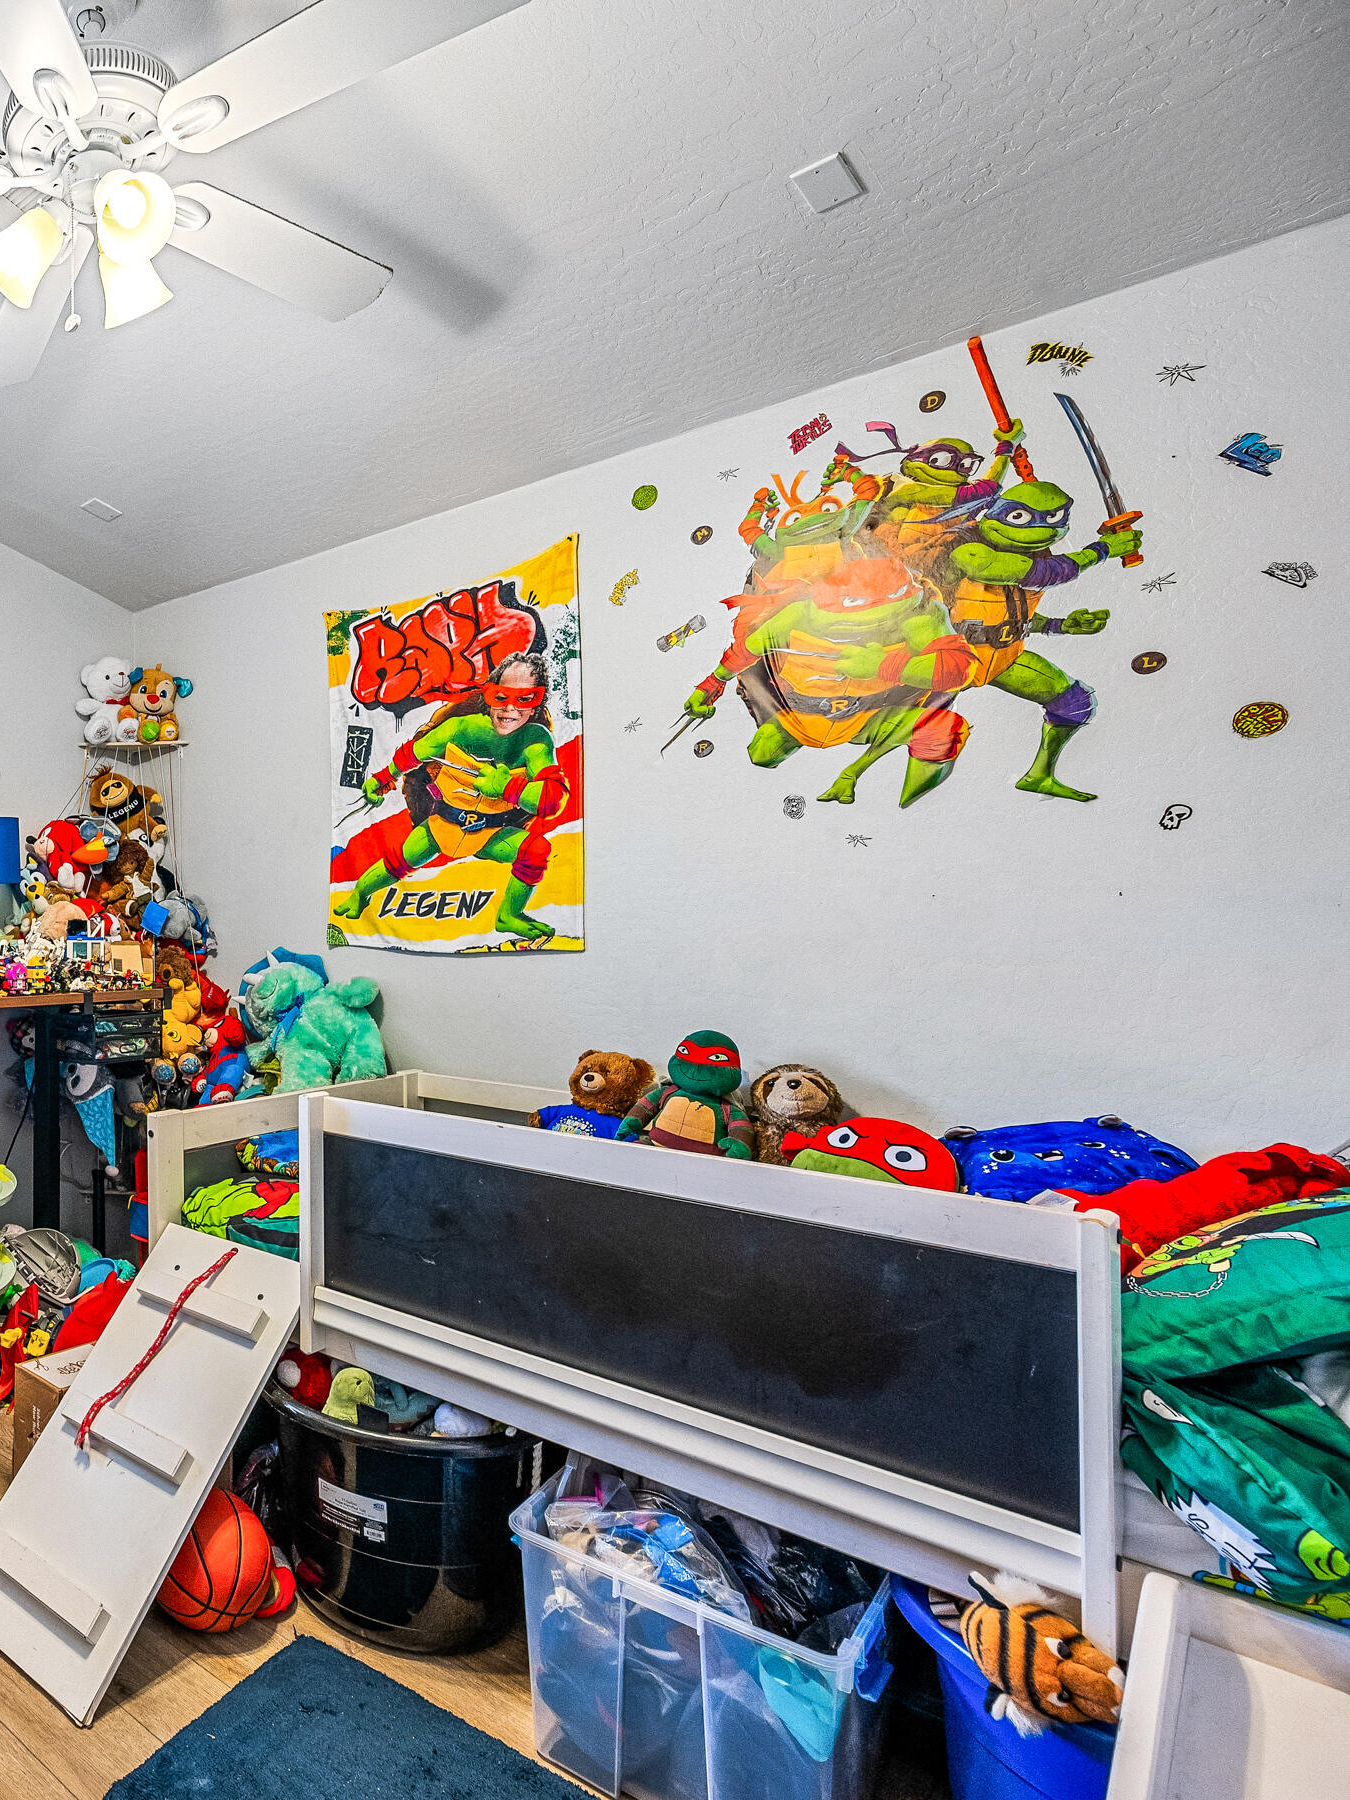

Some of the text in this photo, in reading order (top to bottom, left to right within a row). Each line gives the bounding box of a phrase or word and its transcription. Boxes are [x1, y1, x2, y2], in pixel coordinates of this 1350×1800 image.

[926, 395, 938, 409] D
[695, 528, 708, 540] M
[1142, 656, 1157, 668] L
[830, 699, 849, 713] R
[108, 799, 139, 820] LEGEND
[466, 814, 477, 826] R
[379, 886, 494, 919] LEGEND
